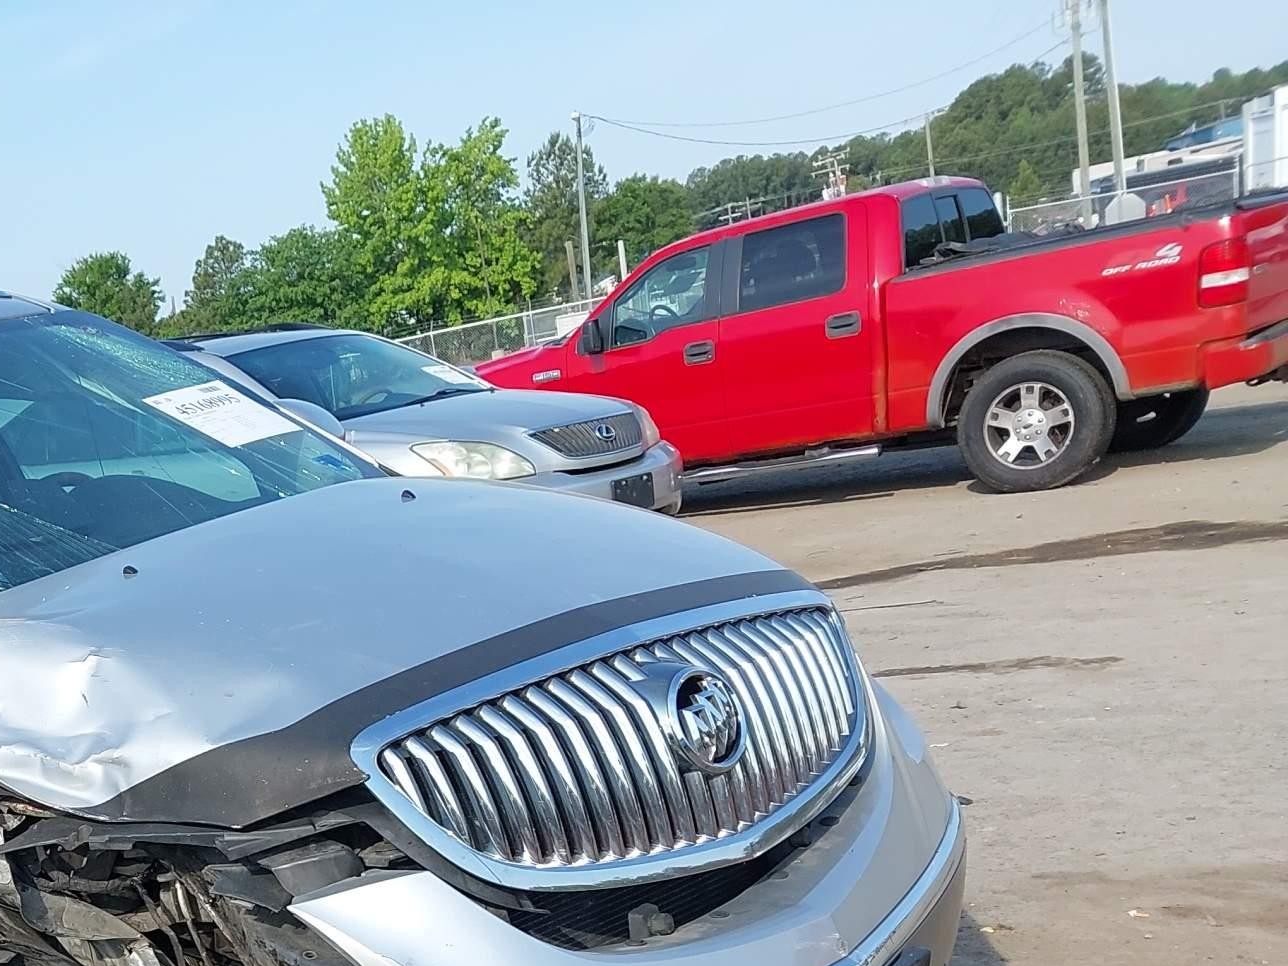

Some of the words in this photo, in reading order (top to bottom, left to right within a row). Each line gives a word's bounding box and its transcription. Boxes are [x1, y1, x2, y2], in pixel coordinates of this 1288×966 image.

[1101, 264, 1133, 277] OFF
[1135, 256, 1181, 270] ROAD
[175, 393, 241, 416] 45168995
